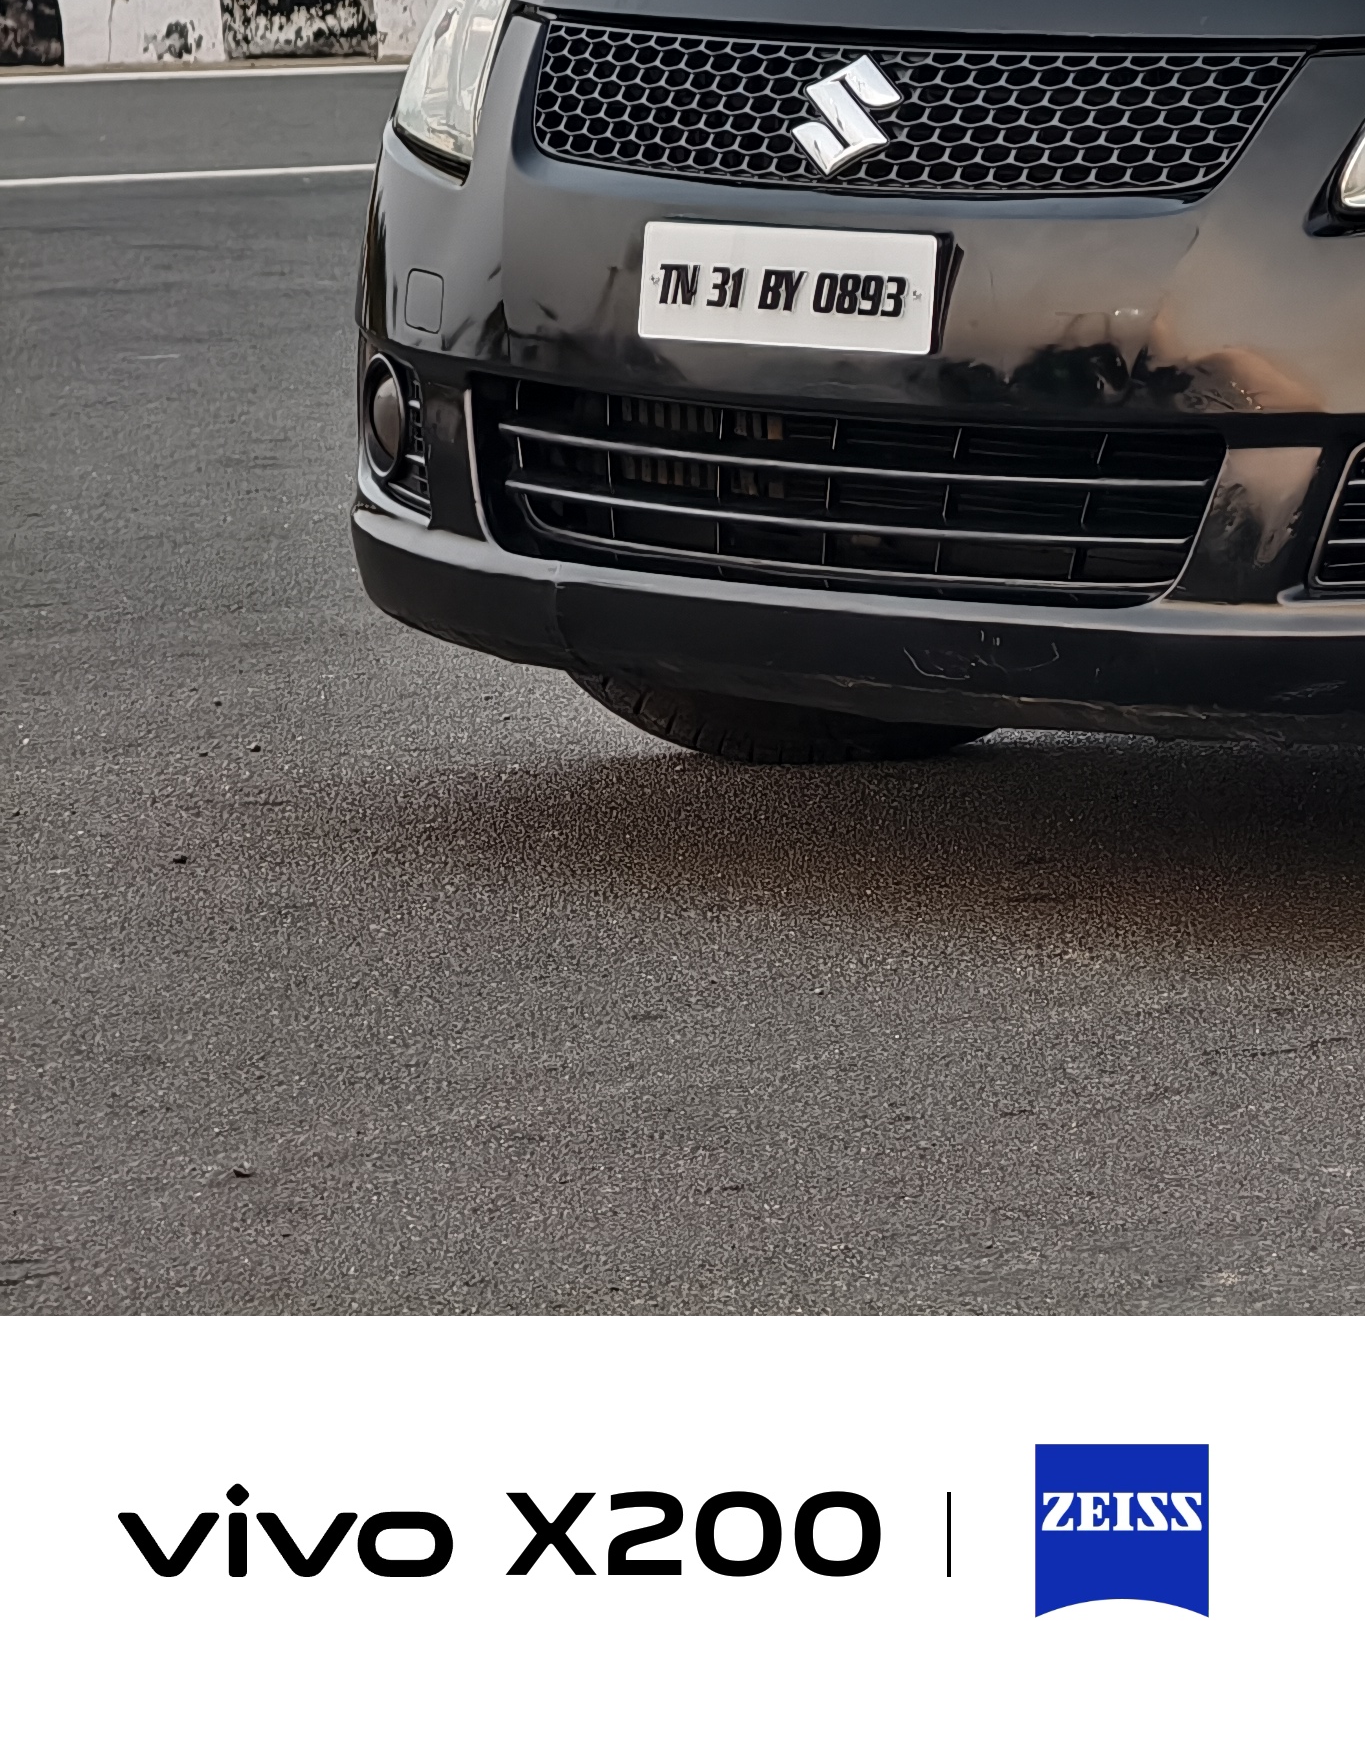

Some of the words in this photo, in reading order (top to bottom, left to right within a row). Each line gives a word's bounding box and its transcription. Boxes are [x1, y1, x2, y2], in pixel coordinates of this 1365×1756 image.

[658, 264, 700, 306] TN
[706, 267, 747, 310] 31
[757, 269, 807, 313] BY
[812, 272, 908, 318] 0893
